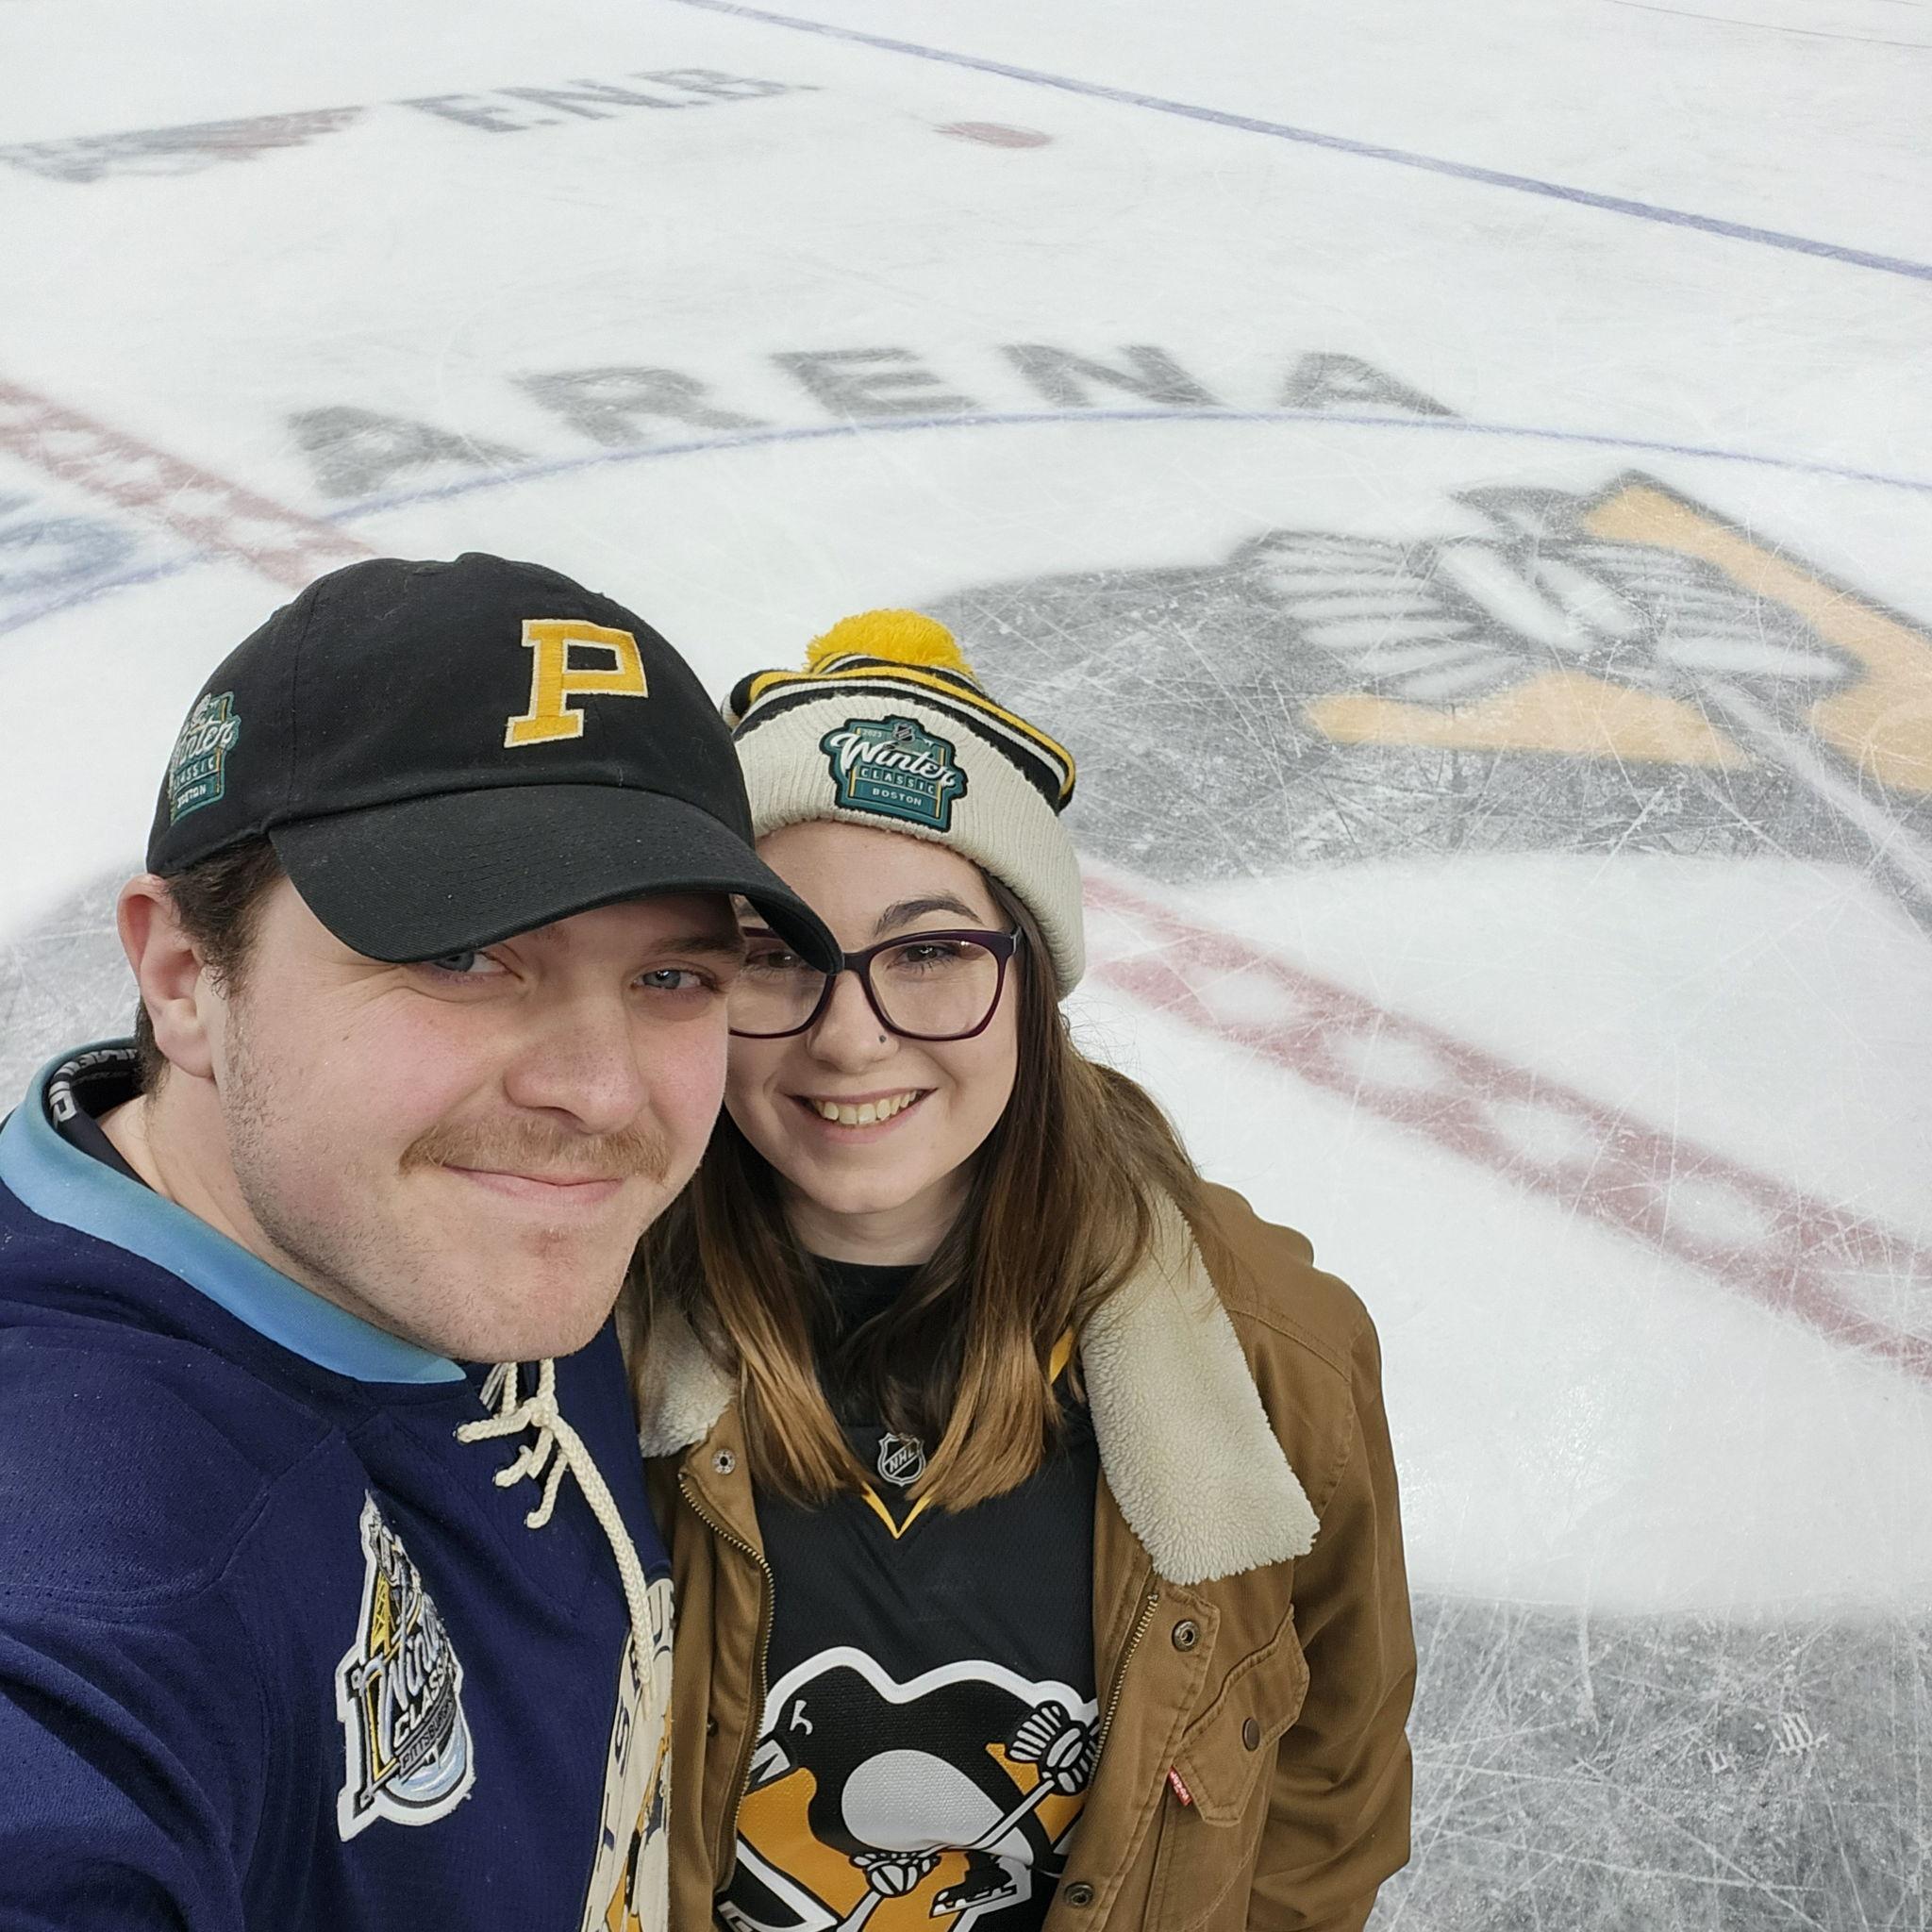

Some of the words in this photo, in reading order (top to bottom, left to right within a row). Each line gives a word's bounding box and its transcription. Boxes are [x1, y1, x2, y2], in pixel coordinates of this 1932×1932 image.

[286, 342, 1463, 500] ARENA
[504, 619, 648, 748] P
[830, 733, 957, 788] Winter
[860, 766, 937, 794] CLASSIC
[872, 787, 922, 807] BOSTON
[889, 1446, 915, 1474] NHL
[392, 1655, 453, 1749] CLASS
